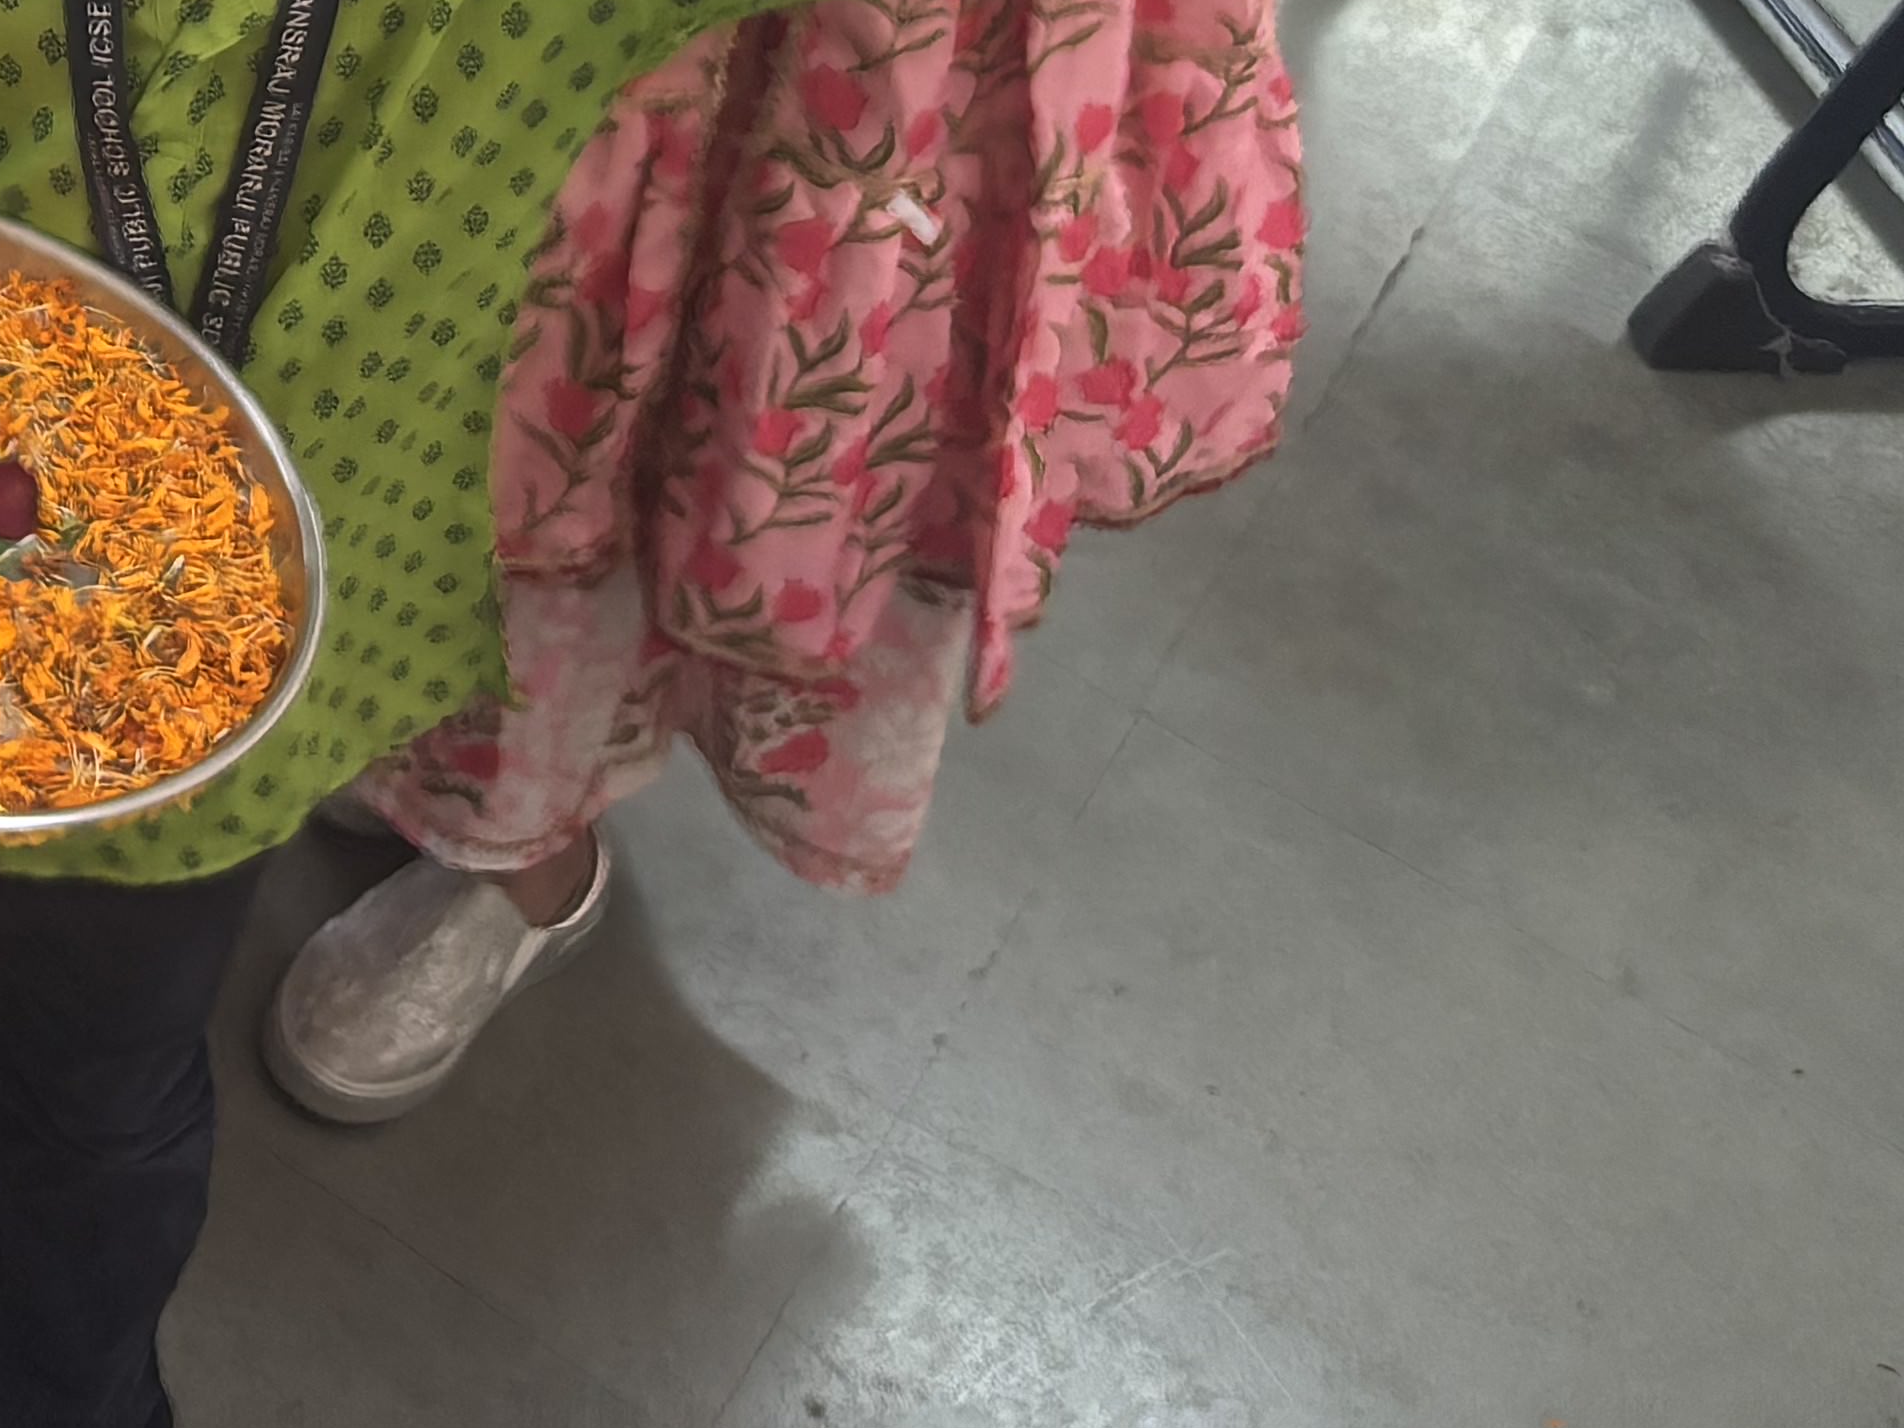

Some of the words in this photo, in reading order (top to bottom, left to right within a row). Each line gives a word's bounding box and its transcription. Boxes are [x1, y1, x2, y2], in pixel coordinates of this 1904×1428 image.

[87, 1, 114, 68] ICSE
[91, 74, 131, 177] SCHOOL
[232, 100, 287, 212] MORARJI
[113, 183, 158, 272] PUBLIC
[208, 217, 252, 307] PUBLIC
